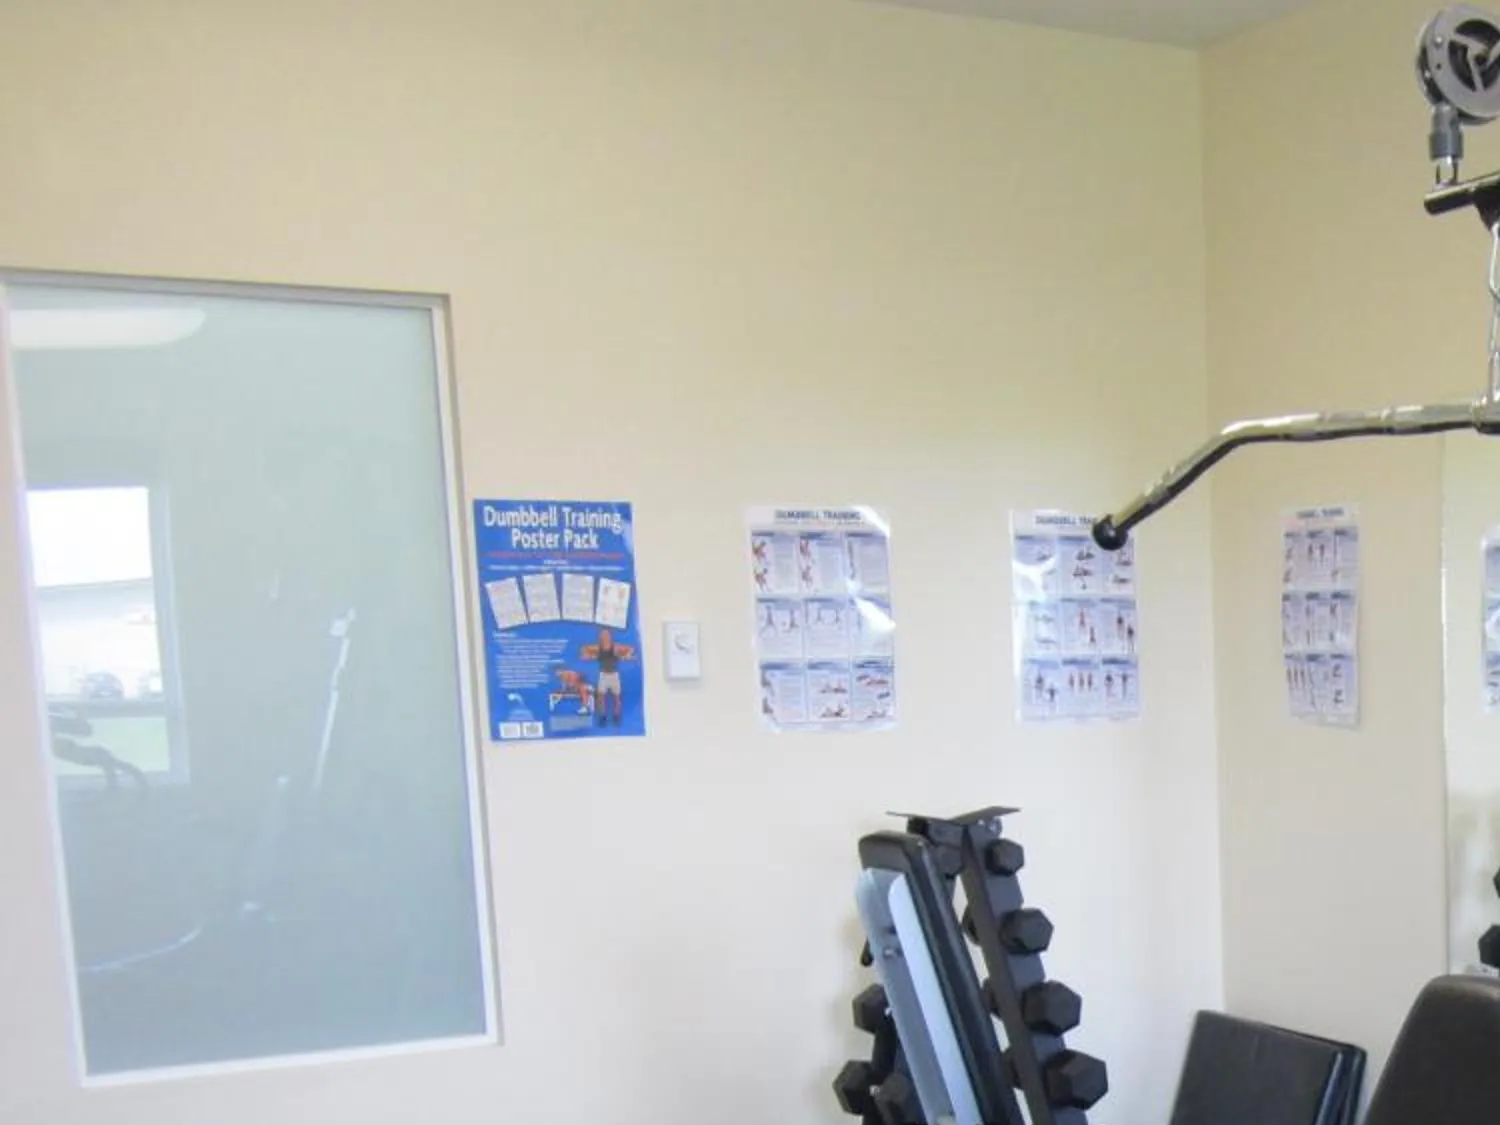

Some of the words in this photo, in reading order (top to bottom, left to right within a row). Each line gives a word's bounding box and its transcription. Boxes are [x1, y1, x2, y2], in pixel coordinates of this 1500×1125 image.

[484, 506, 557, 527] Dumbbell
[562, 507, 622, 534] Training
[511, 527, 560, 549] Poster
[563, 528, 599, 550] Pack
